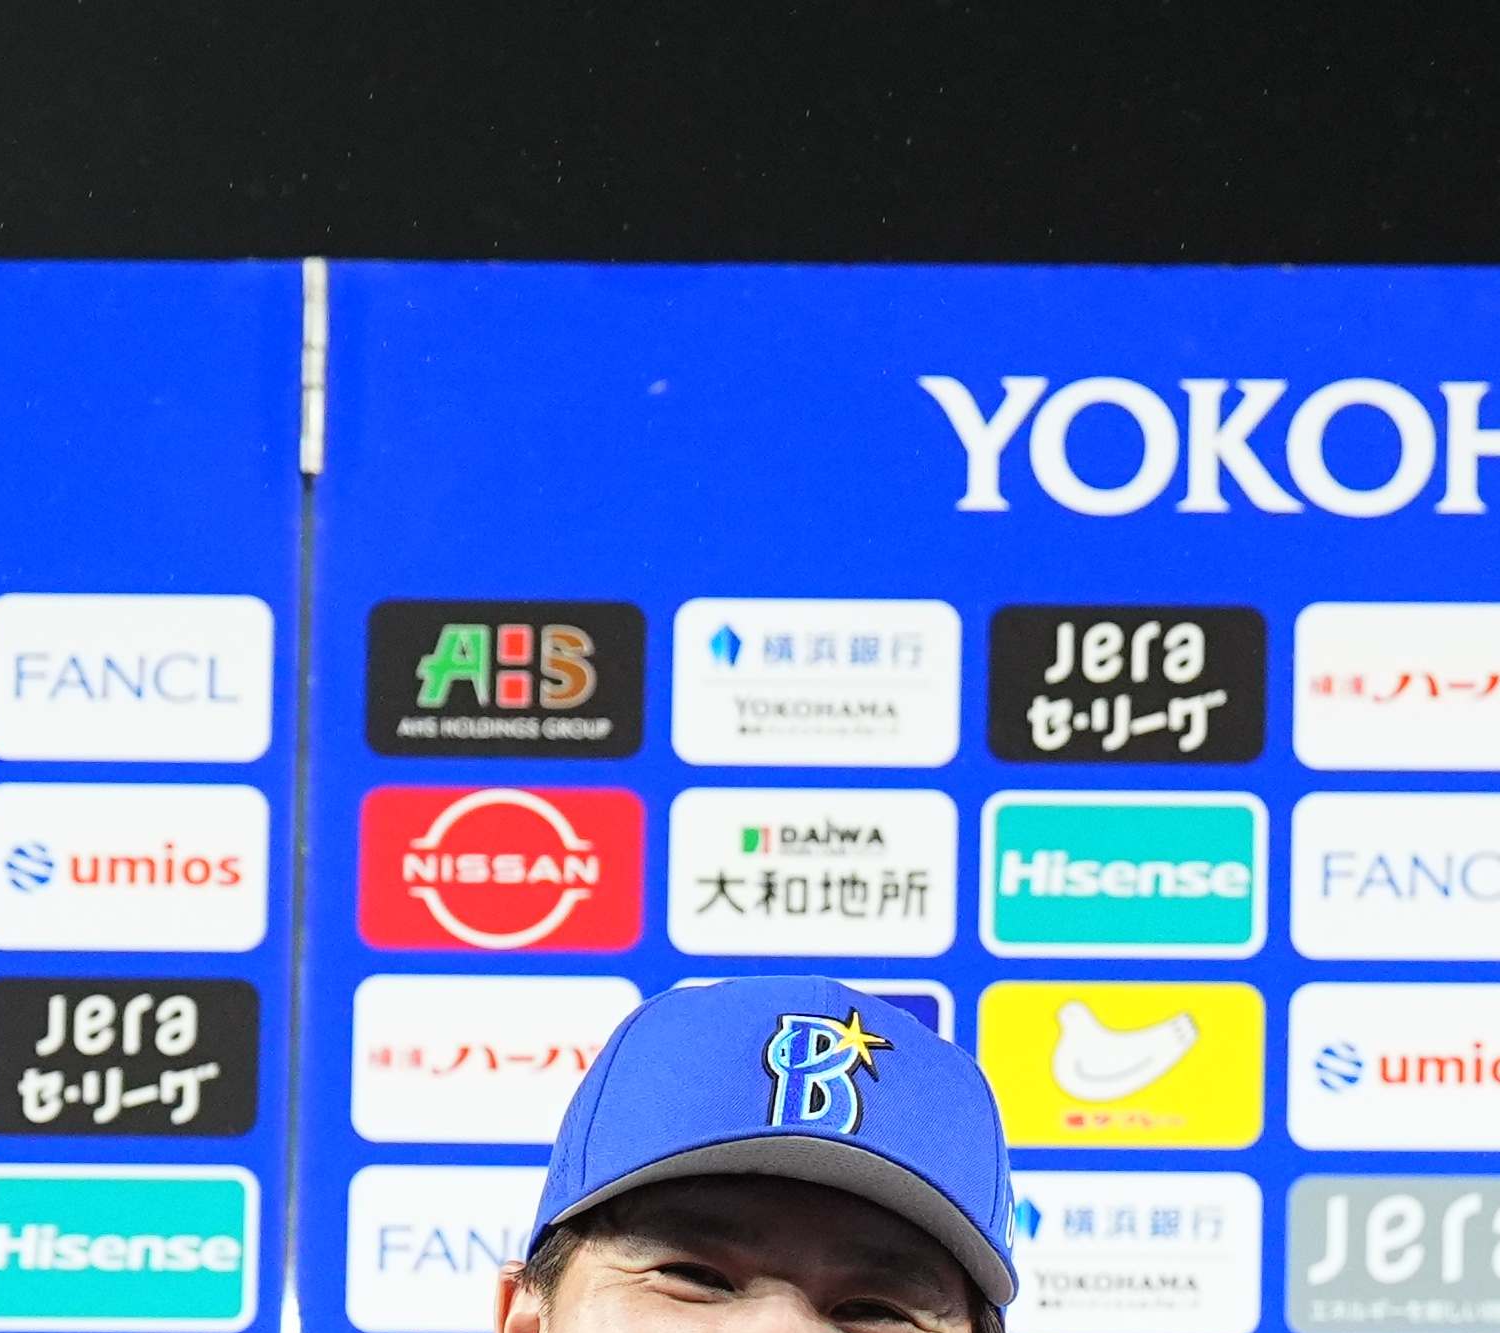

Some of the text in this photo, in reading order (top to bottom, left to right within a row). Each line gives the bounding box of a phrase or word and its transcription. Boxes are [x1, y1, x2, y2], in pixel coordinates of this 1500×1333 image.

[762, 633, 921, 666] 横浜銀行
[13, 652, 237, 703] FANCL
[71, 843, 241, 886] umios
[403, 853, 599, 884] NISSAN
[1002, 853, 1250, 896] Hisense
[698, 870, 928, 917] 大和地所
